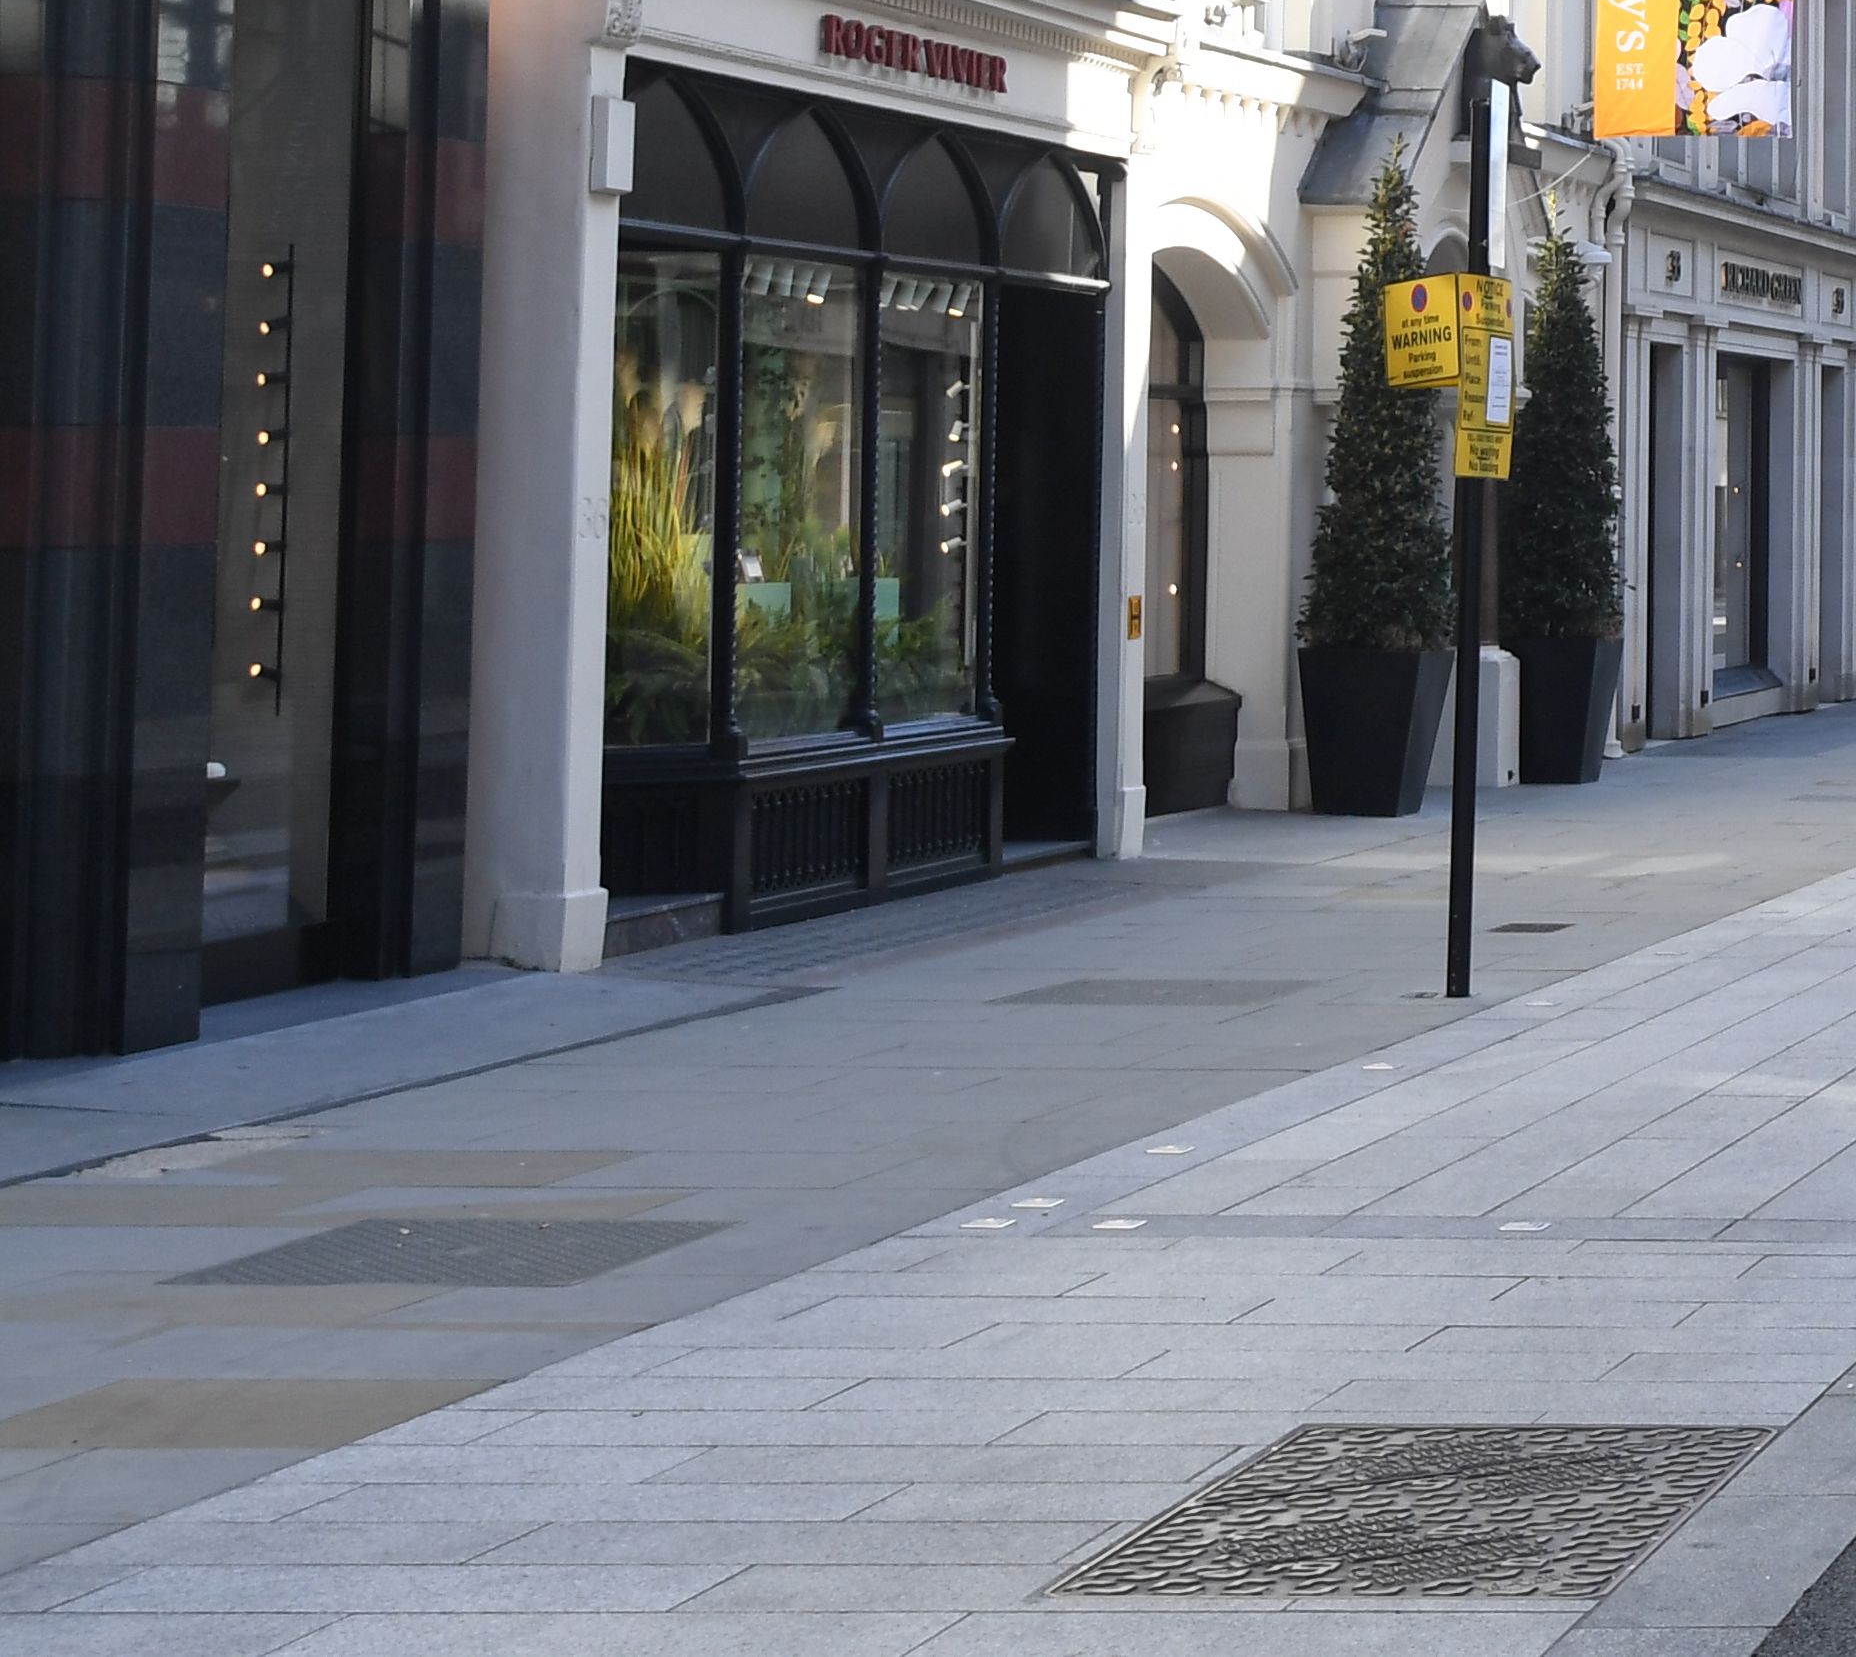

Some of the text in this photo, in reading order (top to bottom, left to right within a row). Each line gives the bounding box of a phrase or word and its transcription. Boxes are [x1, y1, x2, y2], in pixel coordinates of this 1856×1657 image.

[820, 14, 1008, 94] ROGER VIVIER
[1615, 63, 1645, 76] EST.
[1615, 78, 1644, 91] 1744
[1391, 325, 1452, 350] WARNING
[1408, 351, 1437, 363] Parking
